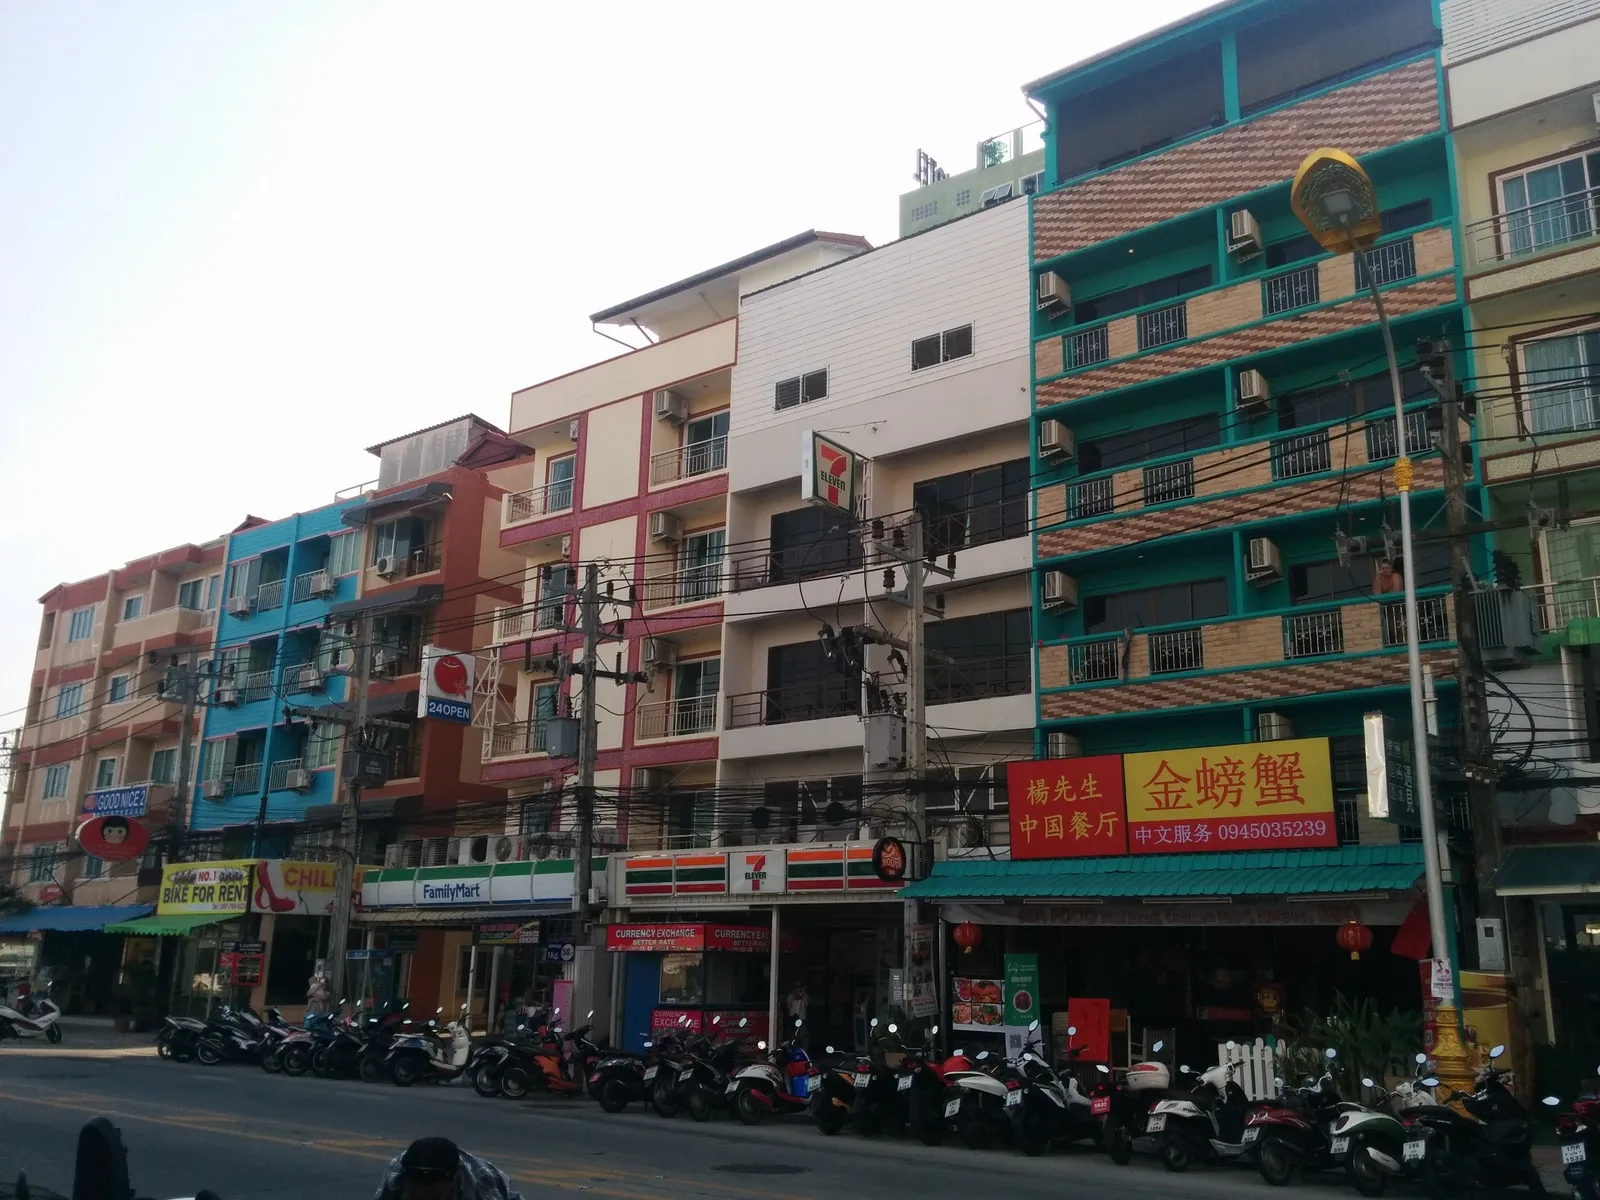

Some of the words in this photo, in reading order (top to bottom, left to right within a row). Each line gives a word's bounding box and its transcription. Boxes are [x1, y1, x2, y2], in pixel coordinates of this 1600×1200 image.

[821, 444, 847, 506] 7
[1026, 773, 1103, 806] 楊先生
[1142, 751, 1306, 811] 金螃蟹
[98, 793, 120, 810] GOOD
[120, 790, 140, 808] NICE
[139, 789, 146, 806] 2
[1019, 810, 1119, 844] 中国餐厅
[1135, 823, 1213, 845] 中文服务
[1218, 819, 1326, 840] 0945035239
[745, 853, 766, 891] 7
[163, 886, 188, 903] BIKE
[192, 885, 214, 903] FOR
[218, 883, 248, 902] RENT
[423, 883, 480, 901] FamilyMart
[615, 929, 656, 938] CURRENCY
[656, 928, 695, 938] EXCHANGE
[714, 929, 756, 939] CURRENCY
[1566, 1154, 1584, 1163] 1532
